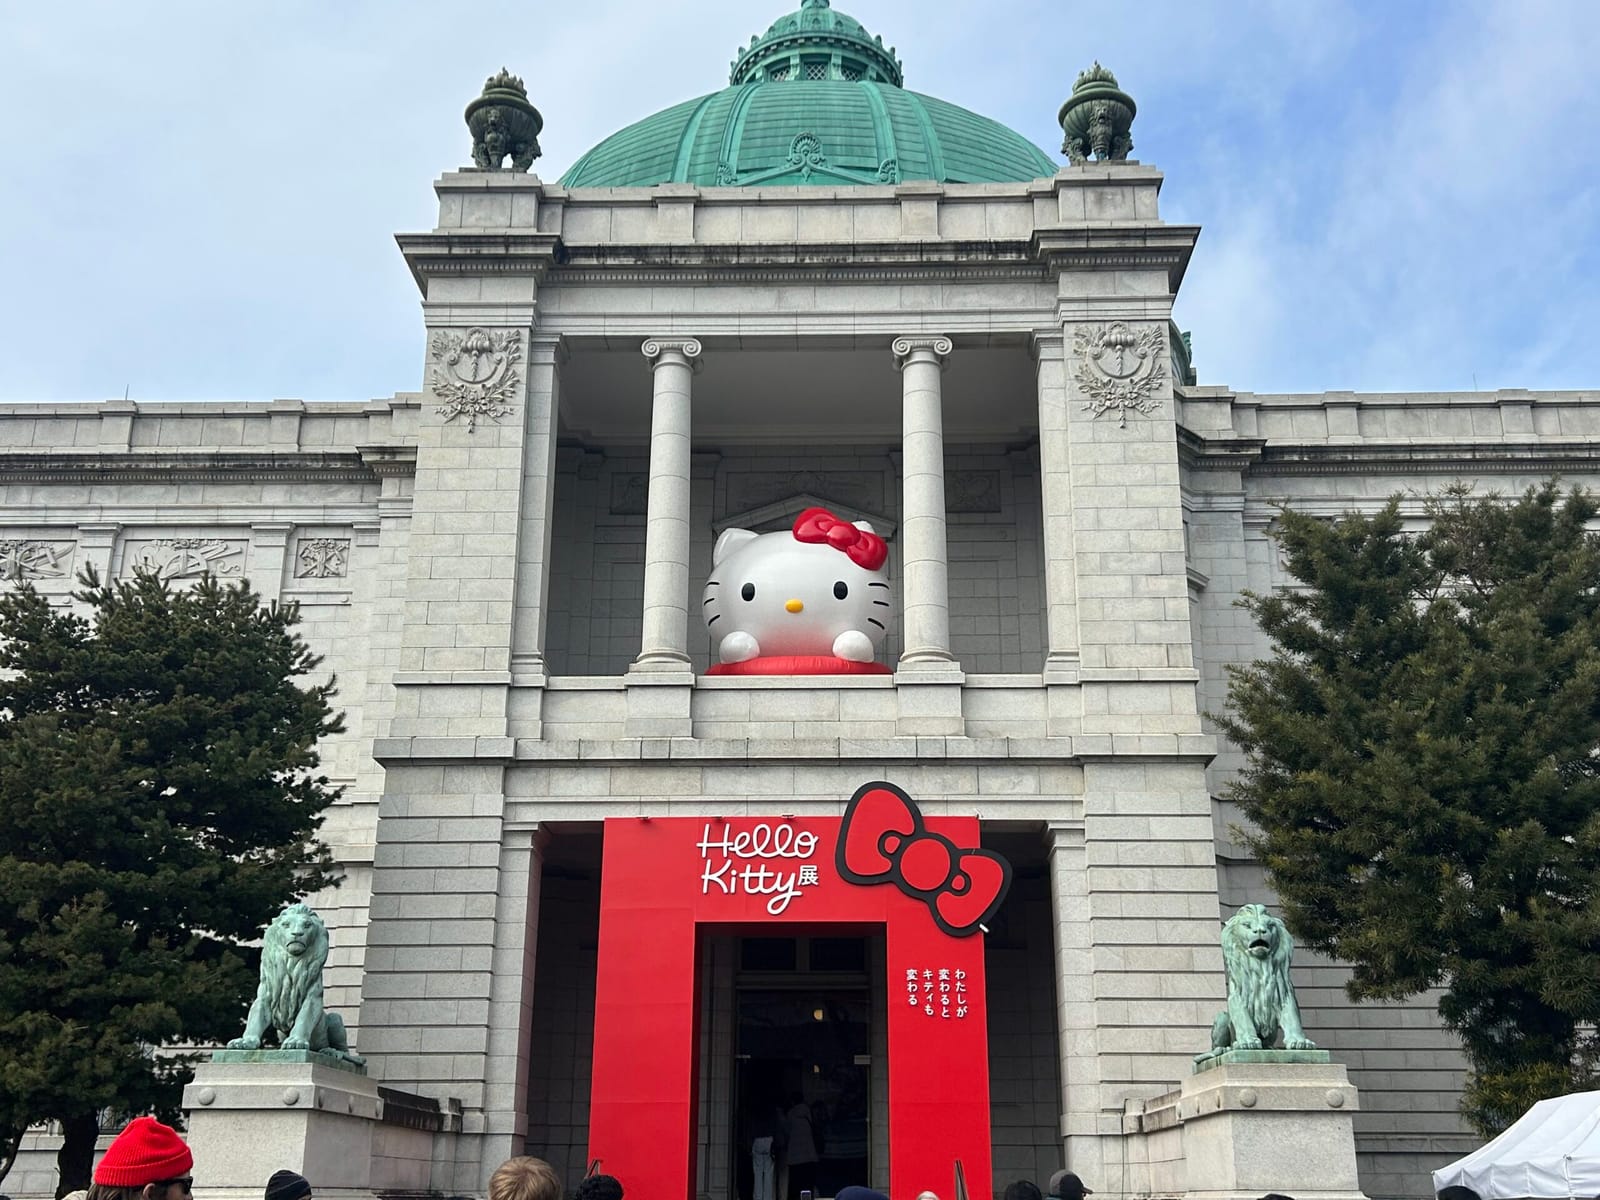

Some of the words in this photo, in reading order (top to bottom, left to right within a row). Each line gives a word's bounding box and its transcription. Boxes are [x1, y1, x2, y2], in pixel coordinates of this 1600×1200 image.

[696, 823, 819, 858] Hello
[906, 969, 918, 1005] 変わる
[923, 969, 934, 1016] キティも
[938, 969, 951, 1018] 変わると
[955, 969, 968, 1018] わたしが
